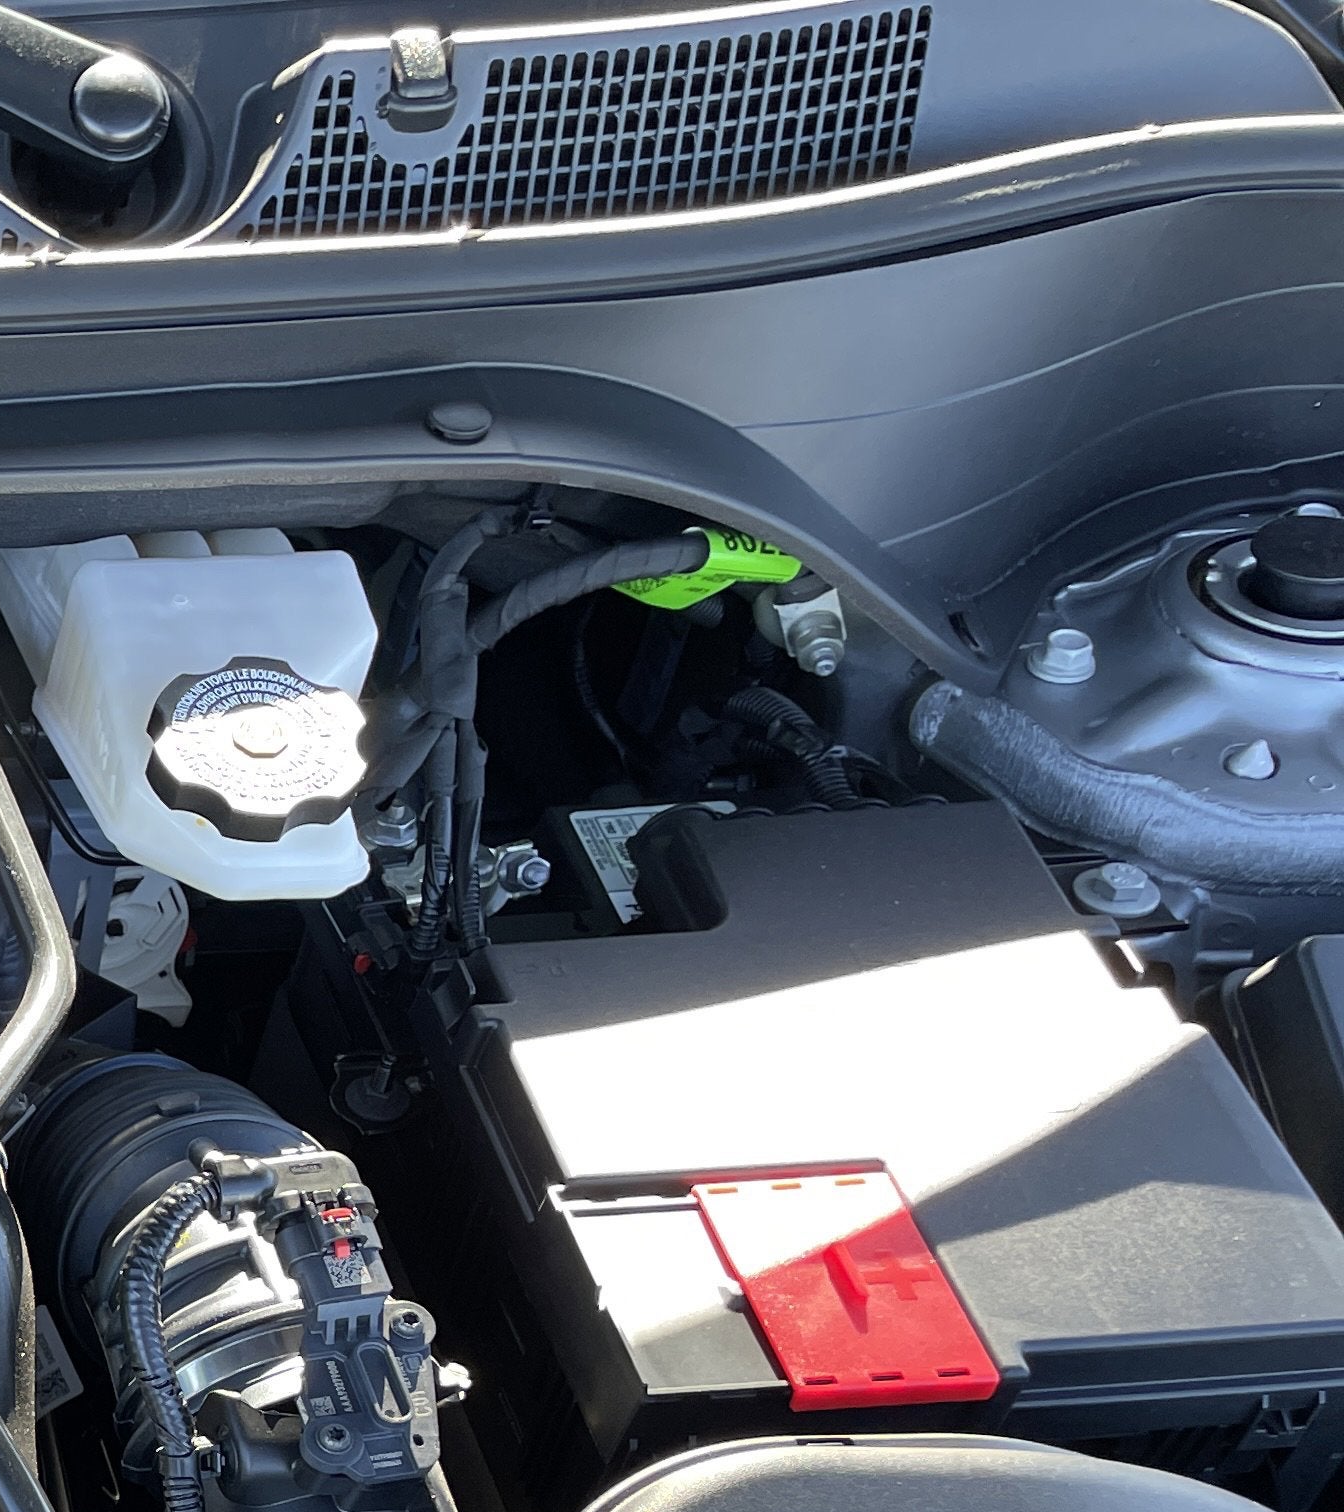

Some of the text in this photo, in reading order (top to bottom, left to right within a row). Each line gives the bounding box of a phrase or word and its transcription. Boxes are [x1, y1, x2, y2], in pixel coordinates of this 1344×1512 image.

[235, 668, 250, 680] LE
[250, 669, 298, 687] BOUCHON
[213, 681, 236, 698] QUE
[234, 680, 249, 692] DU
[248, 680, 285, 696] LIQUIDE
